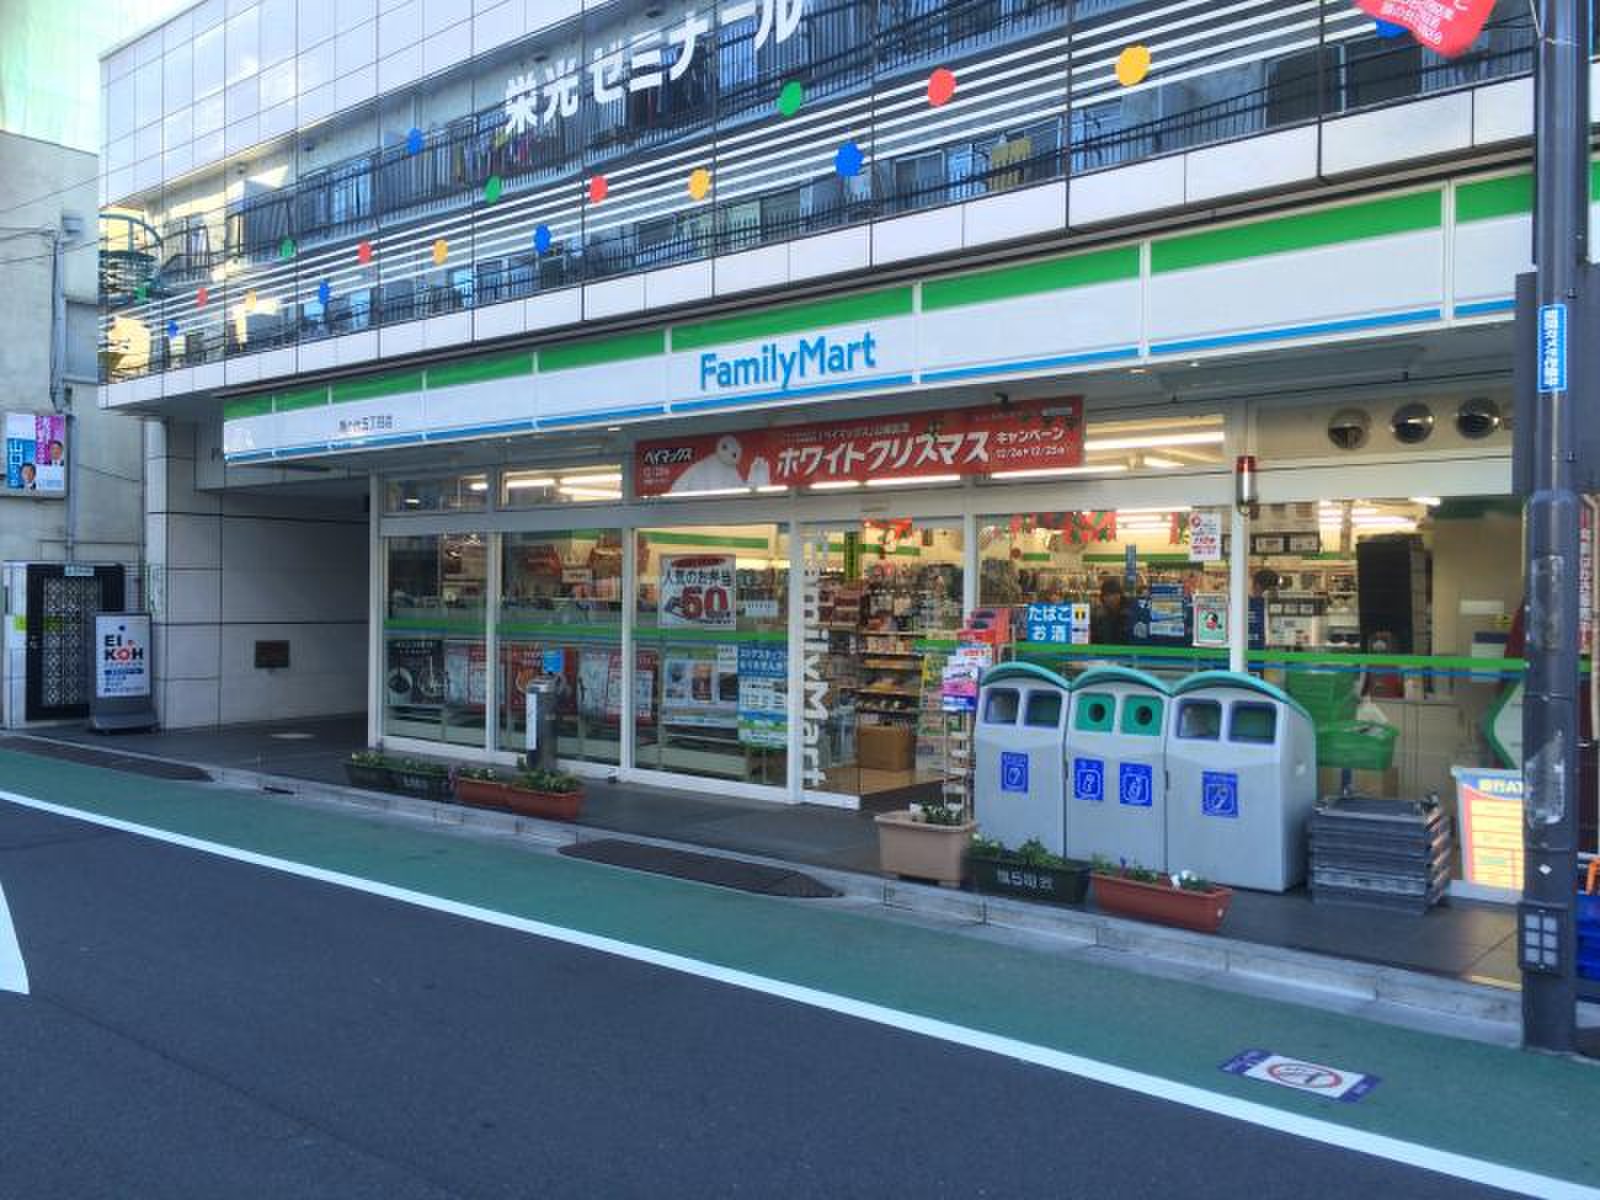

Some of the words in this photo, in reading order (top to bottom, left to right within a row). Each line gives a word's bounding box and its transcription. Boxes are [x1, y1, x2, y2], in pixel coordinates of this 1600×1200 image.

[505, 0, 801, 134] 栄光ゼミナール
[700, 331, 876, 391] FamilyMart
[996, 427, 1065, 445] キャンペーン
[777, 431, 990, 478] ホワイトクリスマス
[663, 568, 732, 587] 人気のお弁当
[1029, 606, 1071, 622] たばこ
[105, 634, 122, 647] EI
